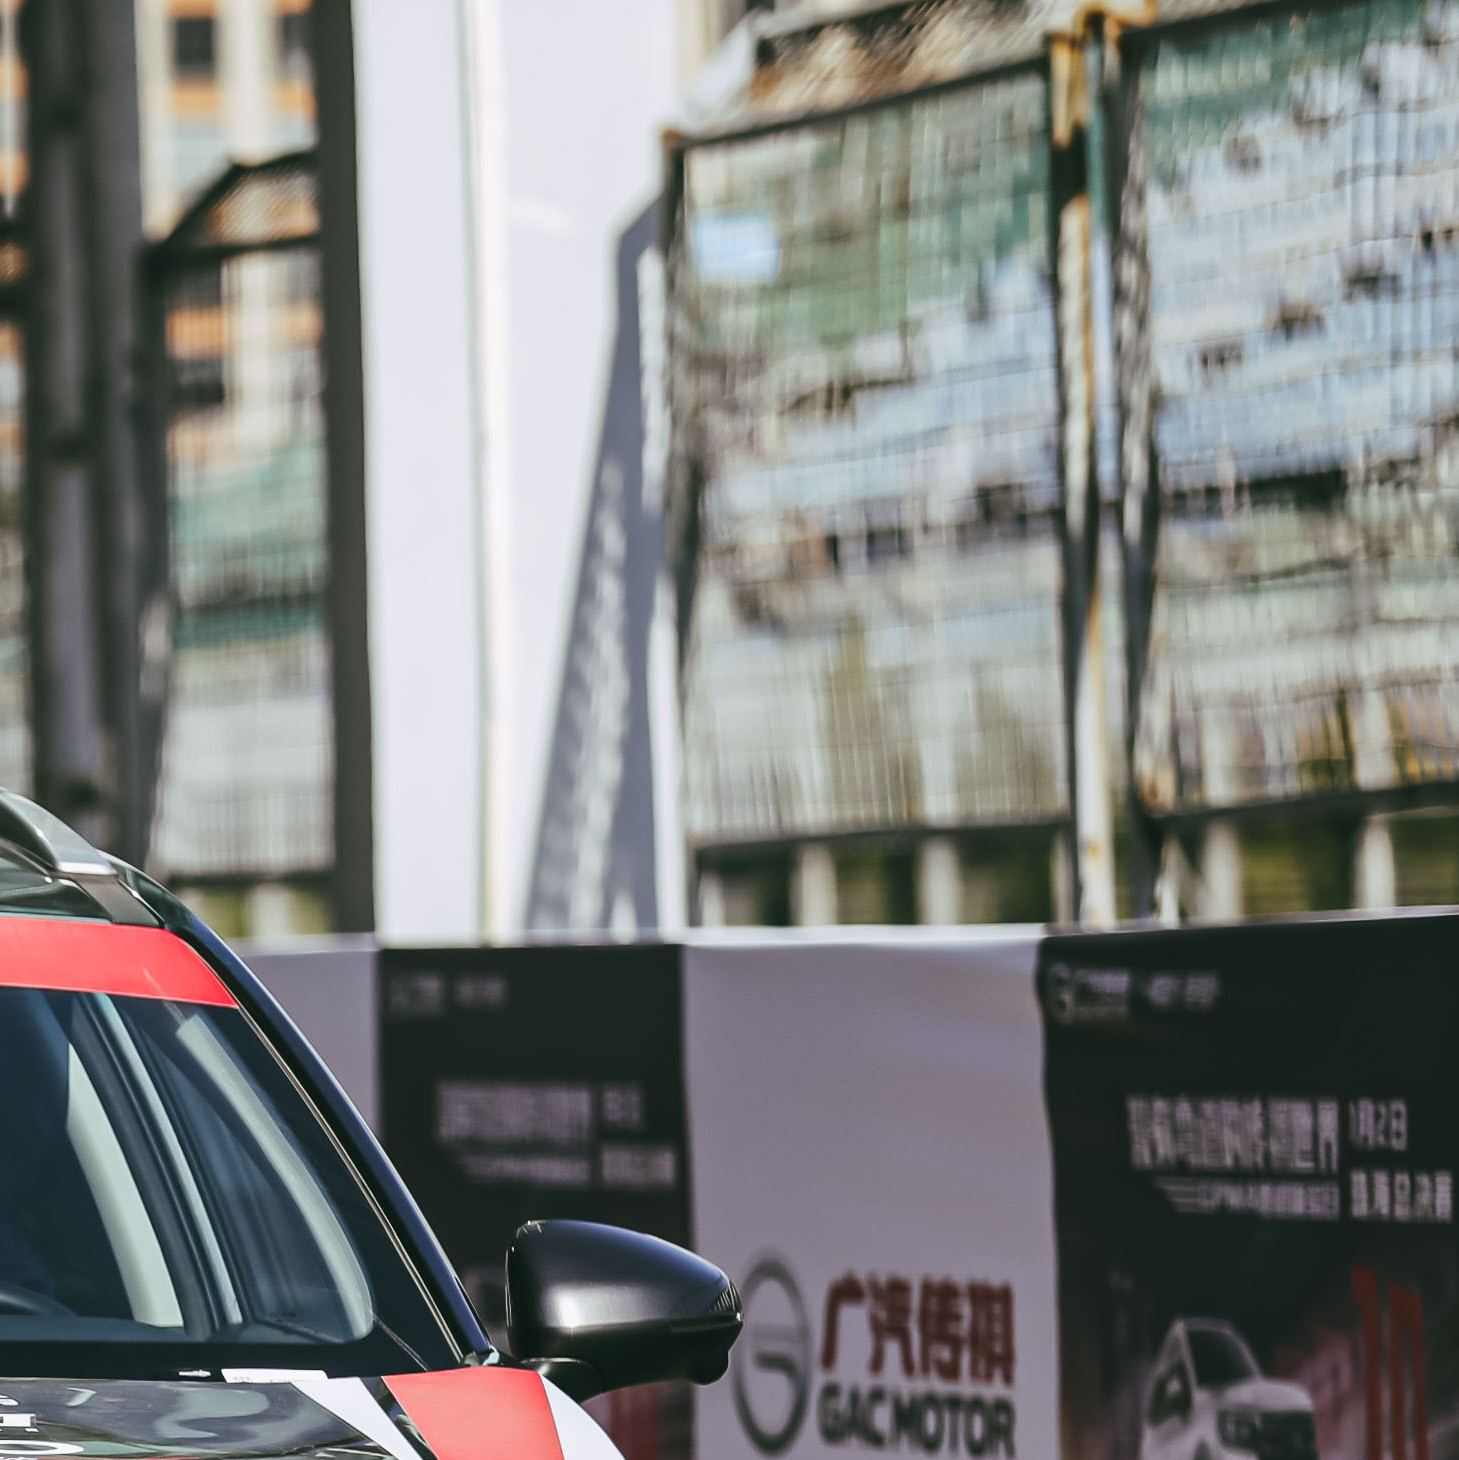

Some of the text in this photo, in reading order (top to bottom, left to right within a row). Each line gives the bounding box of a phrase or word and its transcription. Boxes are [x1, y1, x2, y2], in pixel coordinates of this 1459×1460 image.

[822, 1271, 1014, 1385] 广汽传祺
[892, 1391, 1015, 1460] MOTOR
